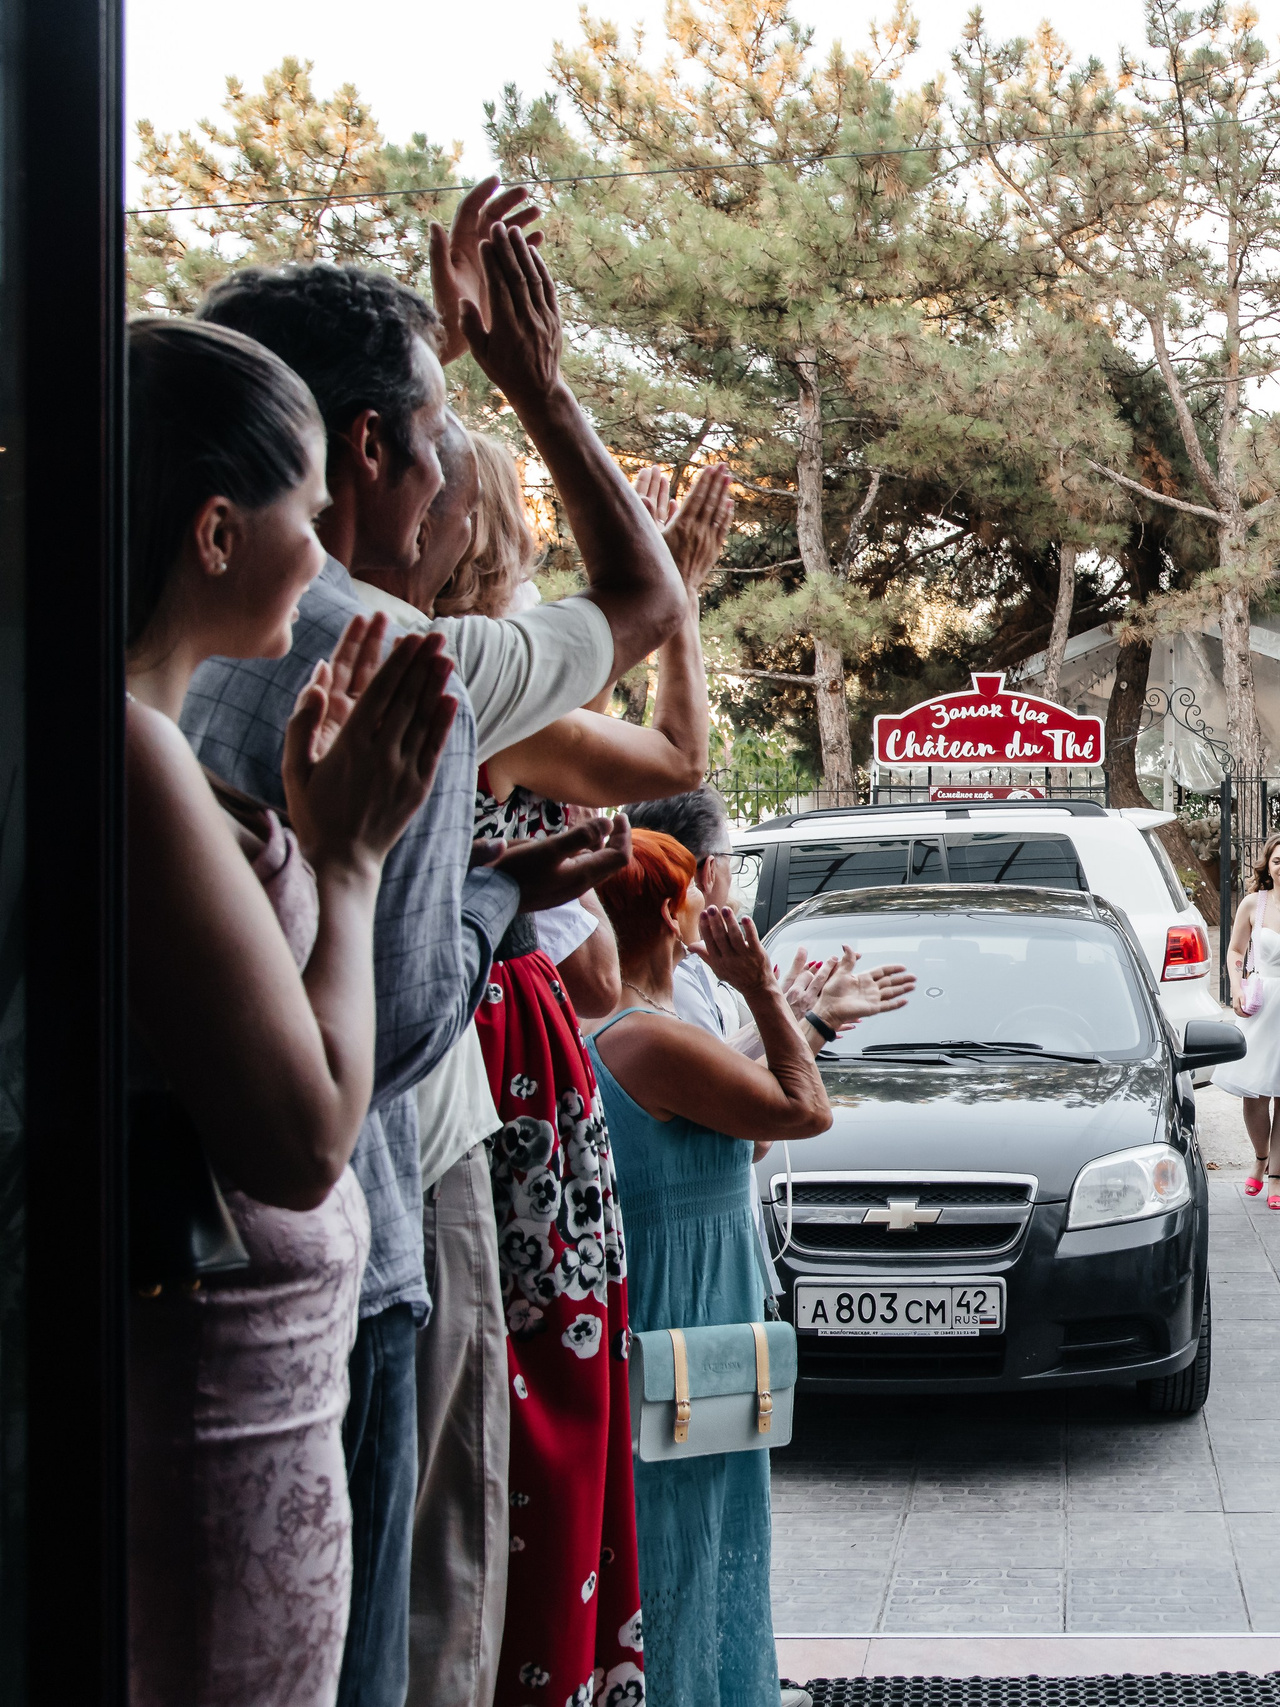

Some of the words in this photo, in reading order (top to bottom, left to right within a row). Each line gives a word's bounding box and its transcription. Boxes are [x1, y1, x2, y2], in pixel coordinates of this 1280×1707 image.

[930, 704, 1003, 729] Замок
[1010, 699, 1049, 725] Чая
[1005, 730, 1044, 759] du
[1042, 729, 1094, 761] Thé
[937, 790, 973, 799] Семейное
[974, 791, 994, 800] кафе
[956, 1290, 988, 1314] 42
[955, 1315, 979, 1324] RUS
